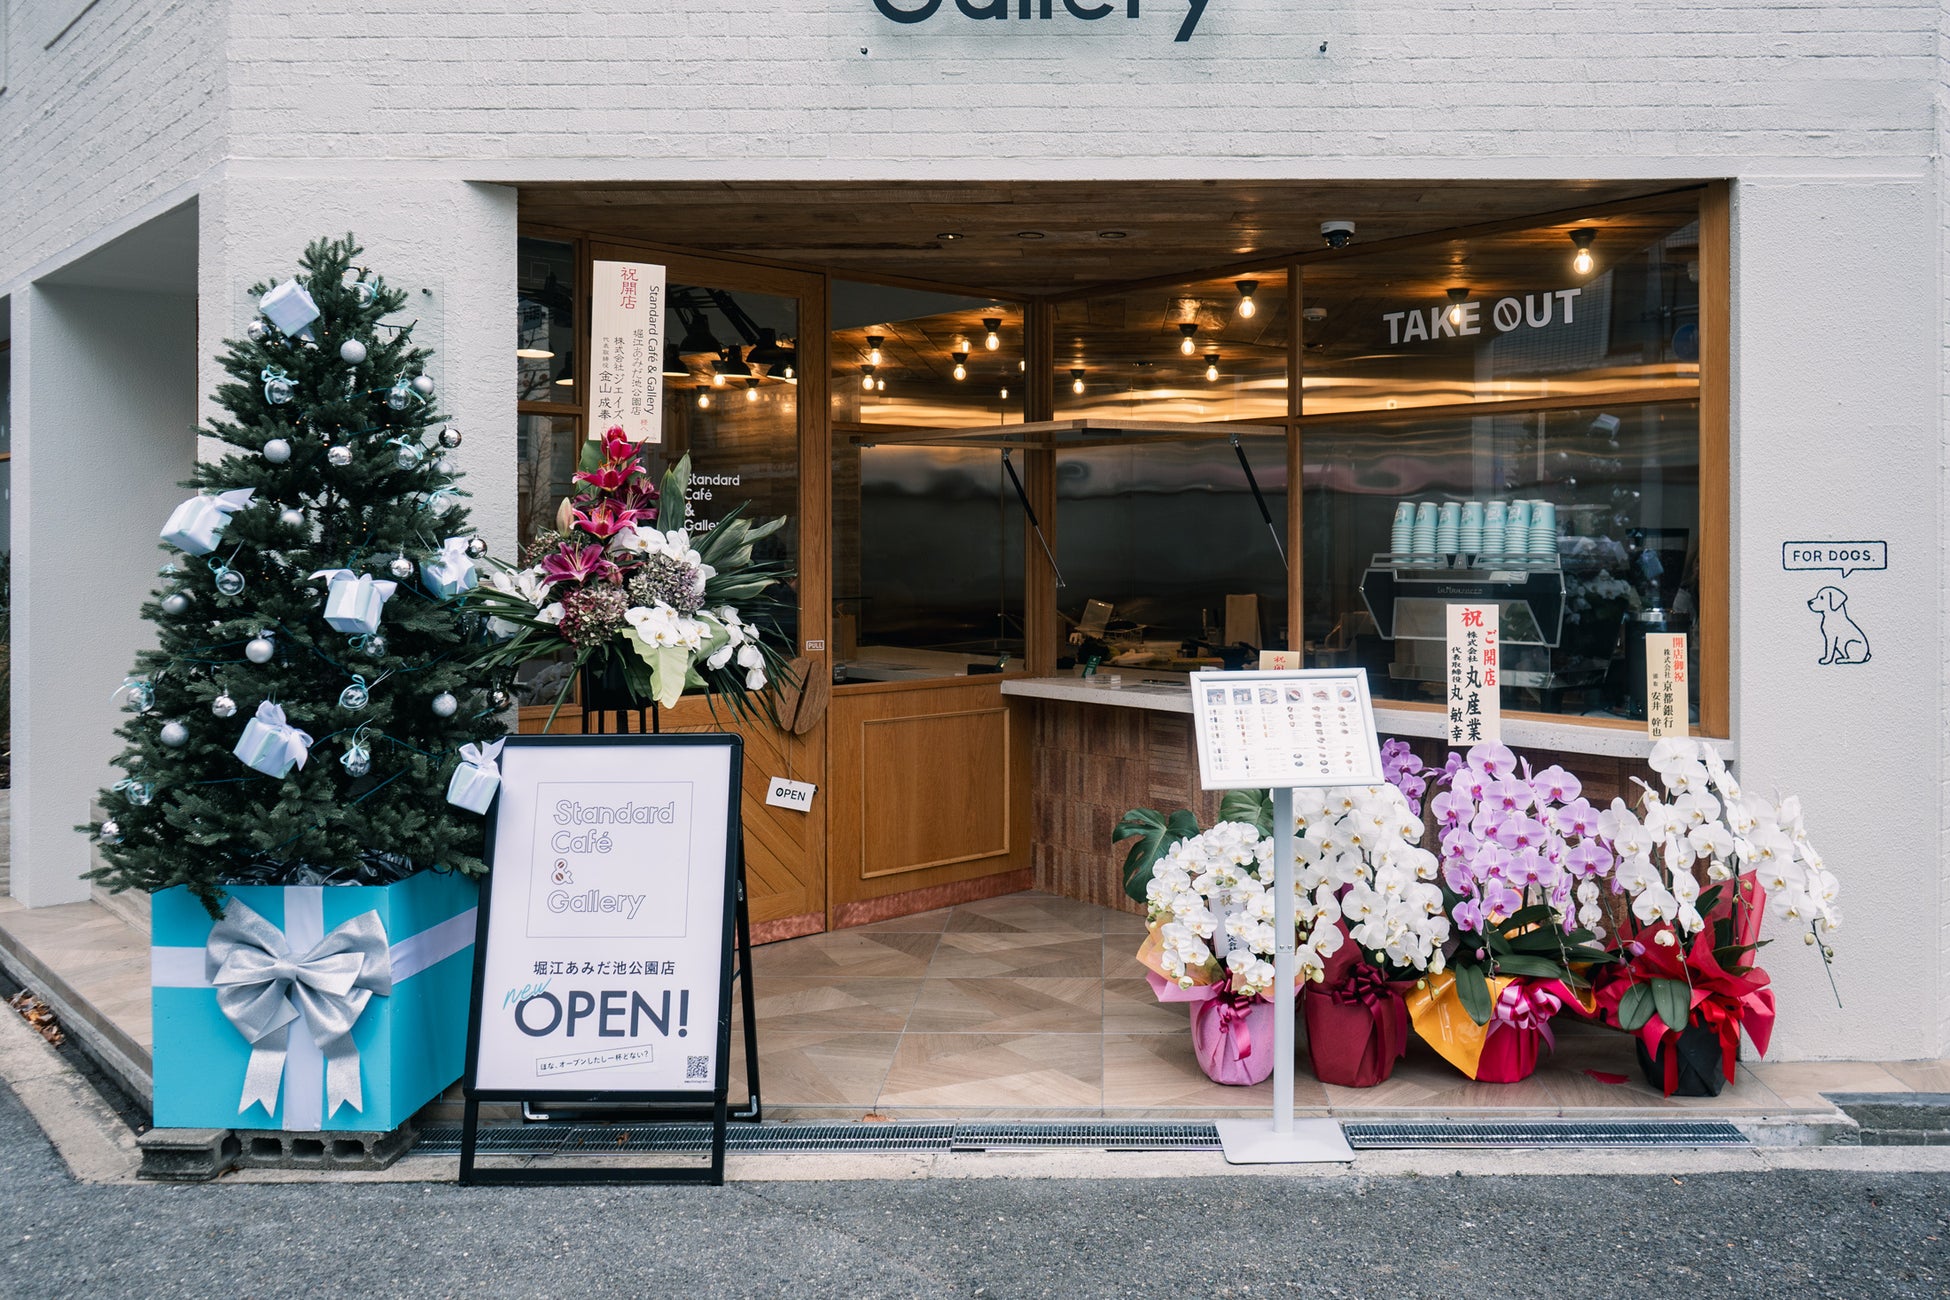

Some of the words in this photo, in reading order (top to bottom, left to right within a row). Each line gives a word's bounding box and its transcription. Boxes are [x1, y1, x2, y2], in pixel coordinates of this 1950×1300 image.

[620, 267, 638, 309] 祝開店
[648, 286, 660, 335] Standard
[1383, 302, 1480, 344] TAKE
[1493, 288, 1581, 332] OUT
[647, 338, 658, 362] Café
[631, 329, 644, 415] 堀江あみだ池公園店
[647, 365, 657, 374] &
[644, 377, 657, 415] Gallery
[684, 488, 712, 500] Café
[685, 503, 695, 517] &
[684, 519, 719, 531] Galle
[1793, 551, 1822, 562] FOR
[1829, 550, 1875, 562] DOGS.
[1461, 608, 1484, 627] 祝
[1483, 629, 1497, 686] ご開店
[1672, 637, 1685, 682] 開店御祝
[1465, 631, 1482, 742] 株式会社丸産業
[1663, 649, 1674, 728] 株式会社京都銀行
[775, 787, 806, 801] OPEN
[553, 799, 675, 825] Standard
[551, 829, 613, 854] Café
[551, 858, 574, 885] &
[547, 889, 646, 919] Gallery
[533, 961, 675, 976] 堀江あみだ池公園店
[503, 978, 551, 1010] new
[514, 989, 690, 1038] OPEN!
